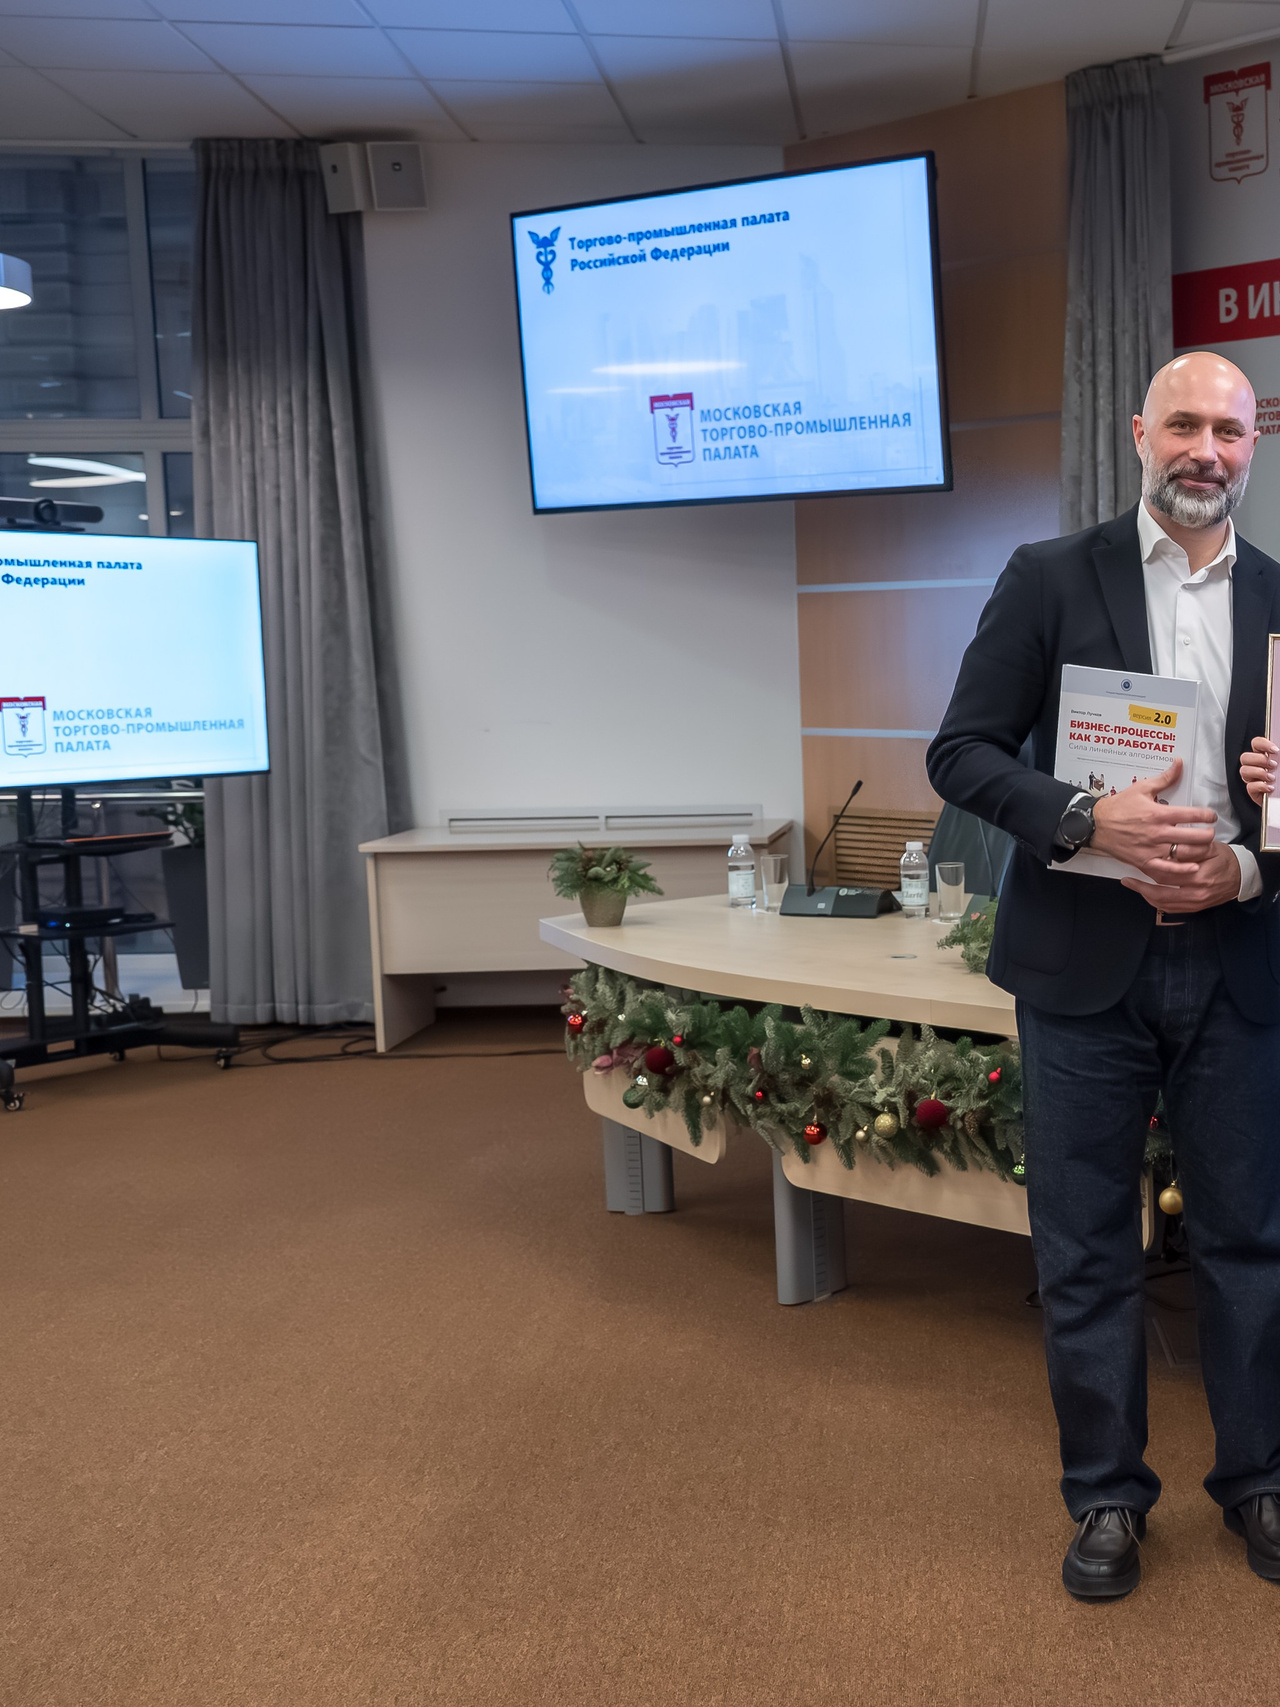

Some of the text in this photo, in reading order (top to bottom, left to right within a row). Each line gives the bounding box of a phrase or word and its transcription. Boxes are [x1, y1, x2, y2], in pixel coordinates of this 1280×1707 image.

[568, 210, 790, 252] Торгово-промышленная палата
[570, 241, 730, 271] Российской Федерации
[1218, 287, 1238, 324] В
[700, 401, 802, 423] МОСКОВСКАЯ
[701, 412, 912, 443] ТОРГОВО-ПРОМЫШЛЕННАЯ
[702, 444, 759, 462] ПАЛАТА
[97, 561, 143, 570] палата
[1, 573, 85, 588] Федерации
[53, 707, 153, 721] МОСКОВСКАЯ
[1153, 712, 1172, 725] 2.0
[53, 719, 245, 737] ТОРГОВО-ПРОМЫШЛЕННАЯ
[1070, 720, 1176, 741] БИЗНЕС-ПРОЦЕССЫ:
[54, 740, 111, 753] ПАЛАТА
[1069, 732, 1175, 753] КАК ЭТО РАБОТАЕТ
[1068, 743, 1174, 763] Сила линейных алгоритмов
